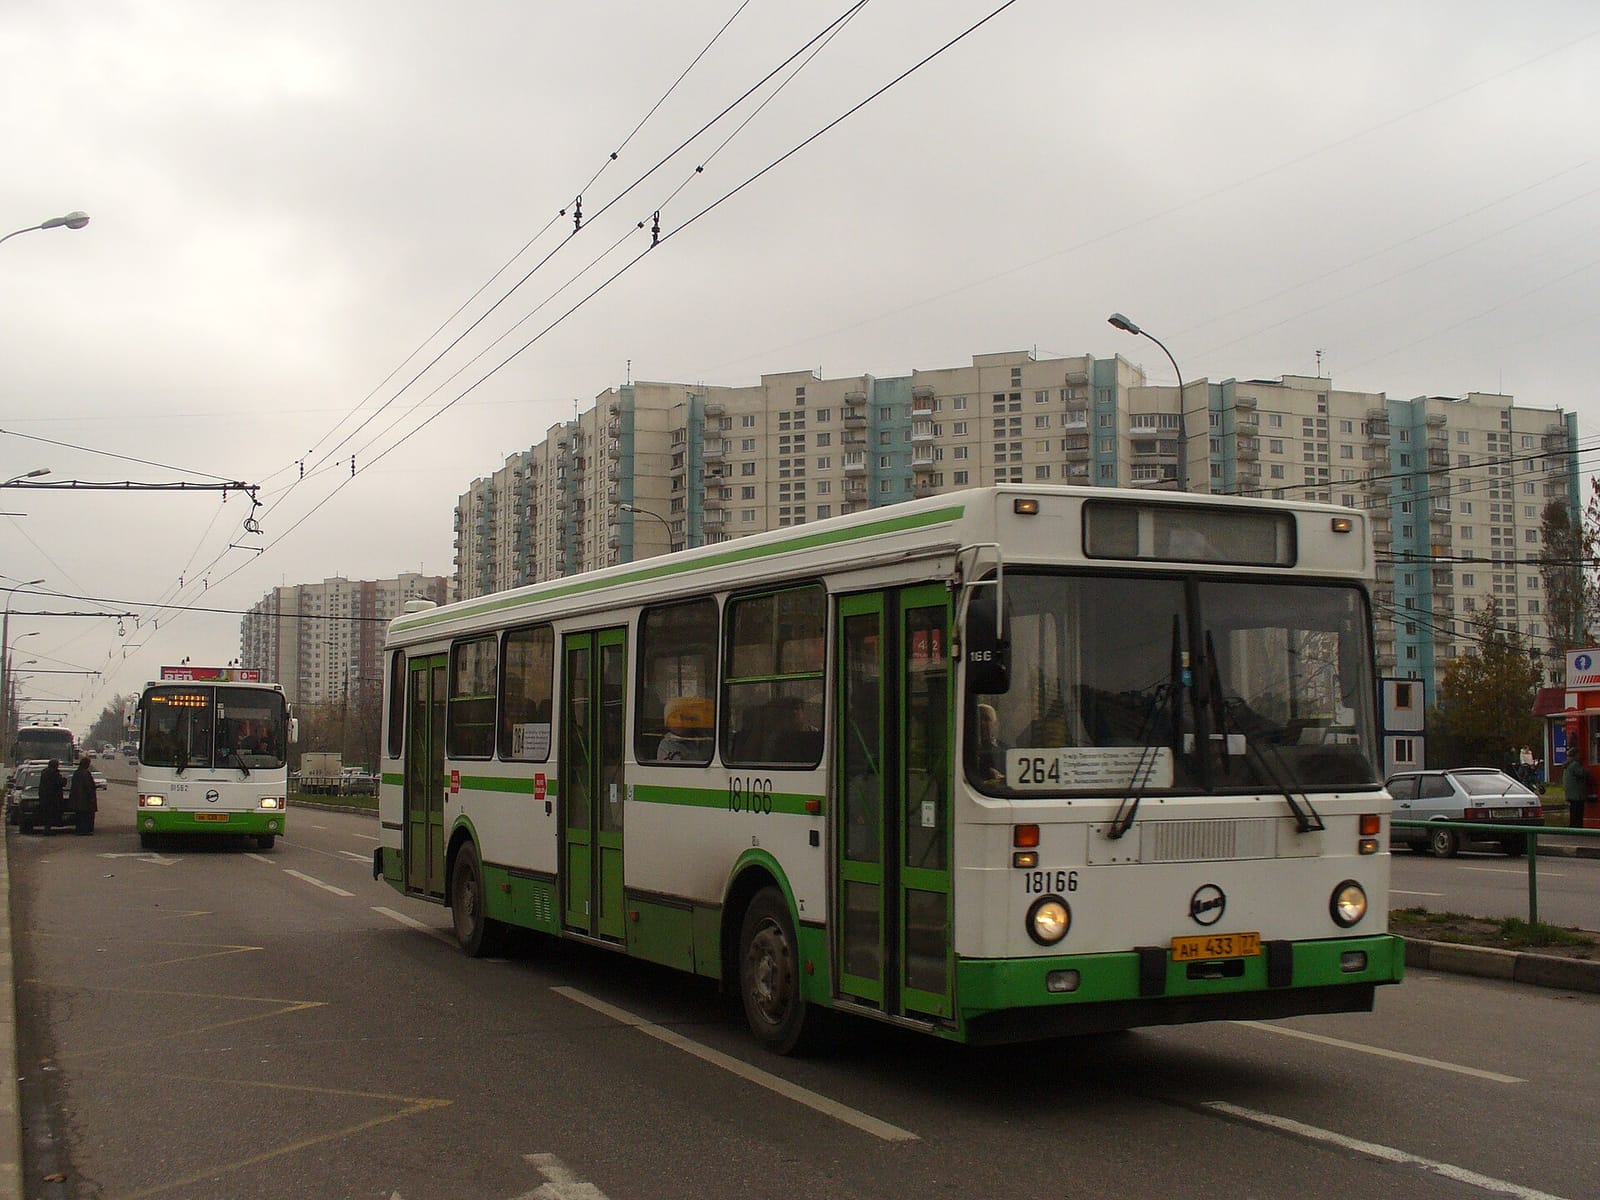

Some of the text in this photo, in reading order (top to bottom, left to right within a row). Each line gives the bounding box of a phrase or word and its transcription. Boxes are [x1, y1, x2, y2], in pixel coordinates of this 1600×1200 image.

[970, 650, 992, 661] 166
[1018, 758, 1060, 784] 264
[728, 776, 773, 815] 18166
[1024, 871, 1078, 893] 18166
[1205, 937, 1233, 955] 433
